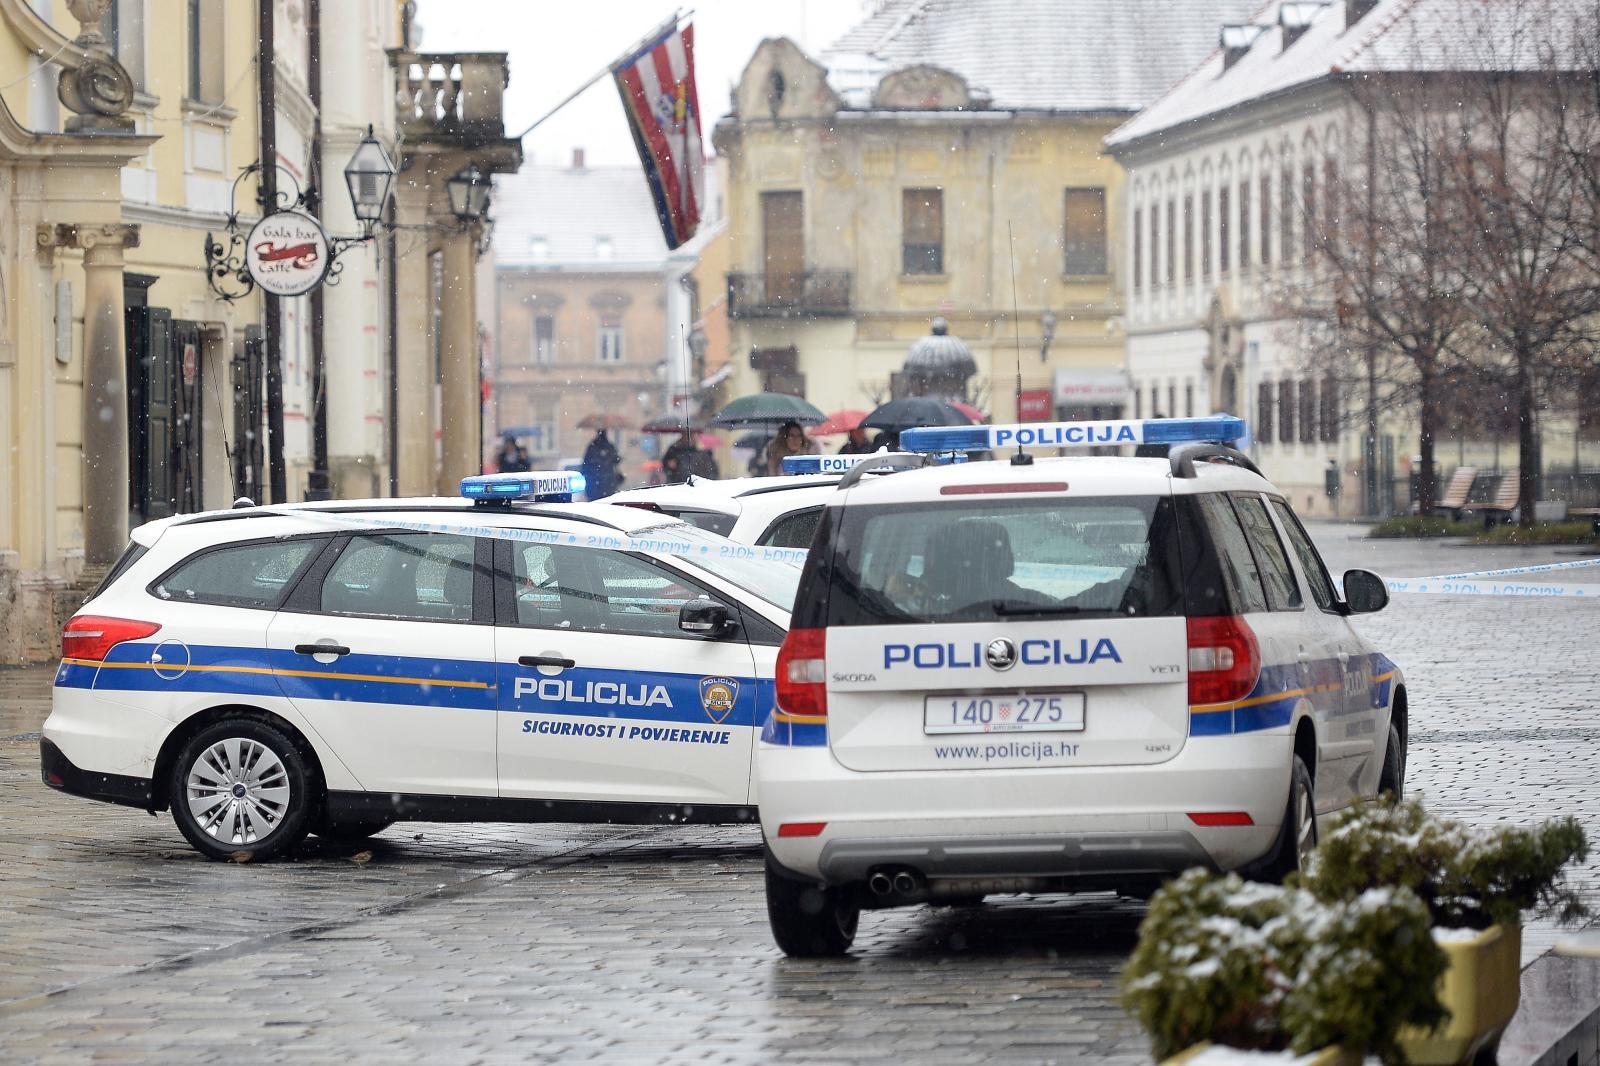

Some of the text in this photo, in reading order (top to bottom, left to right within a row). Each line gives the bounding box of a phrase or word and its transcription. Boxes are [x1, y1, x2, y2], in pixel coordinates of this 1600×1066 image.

[263, 226, 317, 239] Gala bar
[996, 425, 1136, 446] POLICIJA
[824, 459, 862, 471] POLI
[538, 478, 568, 493] POLICIJA
[1150, 665, 1181, 674] YETI
[514, 677, 673, 708] POLICIJA
[702, 678, 737, 689] POLICIJA
[951, 698, 1063, 724] 140 275
[522, 719, 731, 745] SIGURNOST I POVJERENJE
[935, 741, 1080, 762] www.policija.hr
